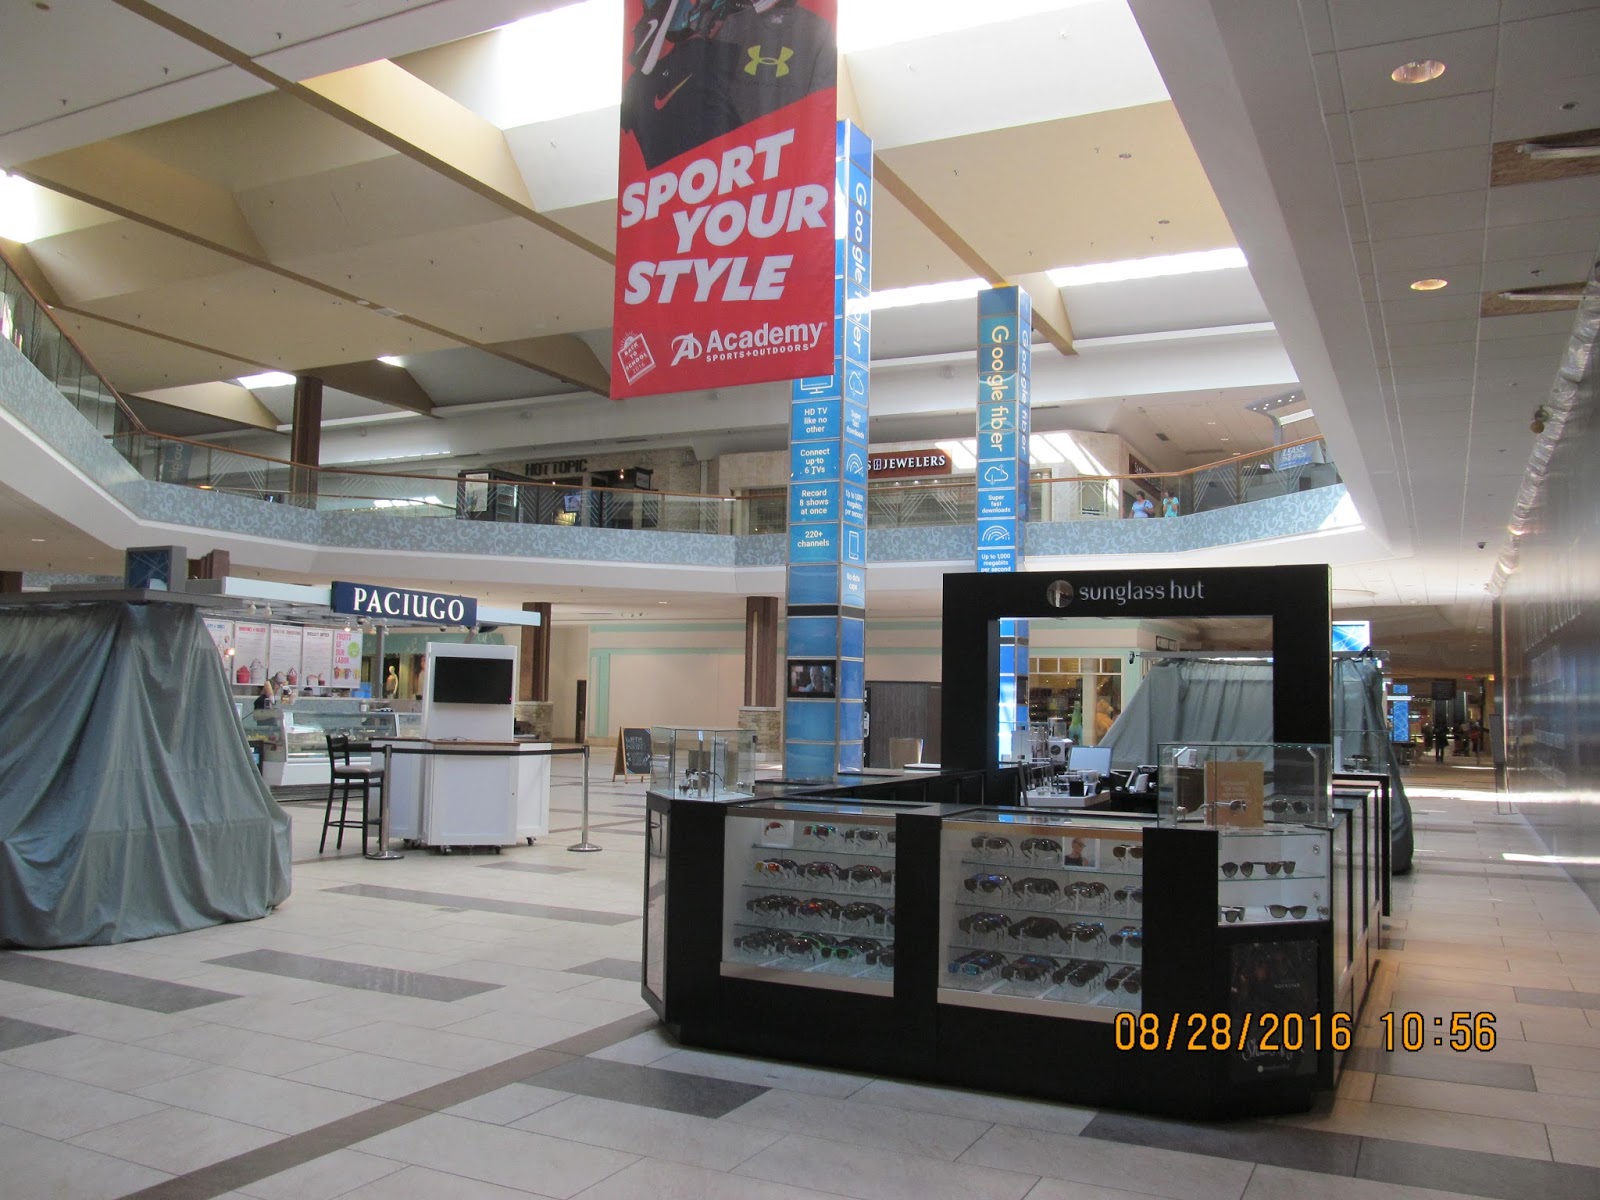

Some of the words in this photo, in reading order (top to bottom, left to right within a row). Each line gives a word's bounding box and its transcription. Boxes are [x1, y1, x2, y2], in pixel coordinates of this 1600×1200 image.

[621, 128, 795, 228] SPORT
[672, 184, 828, 254] YOUR
[852, 182, 867, 285] Google
[624, 254, 794, 305] STYLE
[706, 321, 824, 353] Academy
[624, 341, 639, 356] BACK
[630, 350, 638, 359] TO
[625, 352, 648, 371] SCHOOL
[987, 325, 1010, 401] Google
[804, 408, 815, 416] HD
[817, 407, 828, 415] TV
[803, 417, 816, 425] like
[990, 406, 1009, 452] fiber
[800, 448, 830, 456] Connect
[805, 458, 814, 466] up
[883, 455, 946, 470] JEWELERS
[525, 462, 550, 476] HOT
[552, 459, 588, 474] TOPIC
[811, 465, 825, 474] TVs
[801, 488, 827, 497] Record
[799, 498, 804, 506] 8
[806, 498, 829, 506] shows
[988, 494, 1004, 502] Super
[800, 507, 808, 515] at
[810, 507, 827, 515] once
[982, 506, 1011, 514] downloads
[805, 530, 823, 539] 220+
[797, 538, 830, 548] channels
[981, 553, 988, 561] Up
[1079, 580, 1165, 605] sunglass
[1170, 579, 1204, 600] hut
[353, 587, 465, 621] PACIUGO
